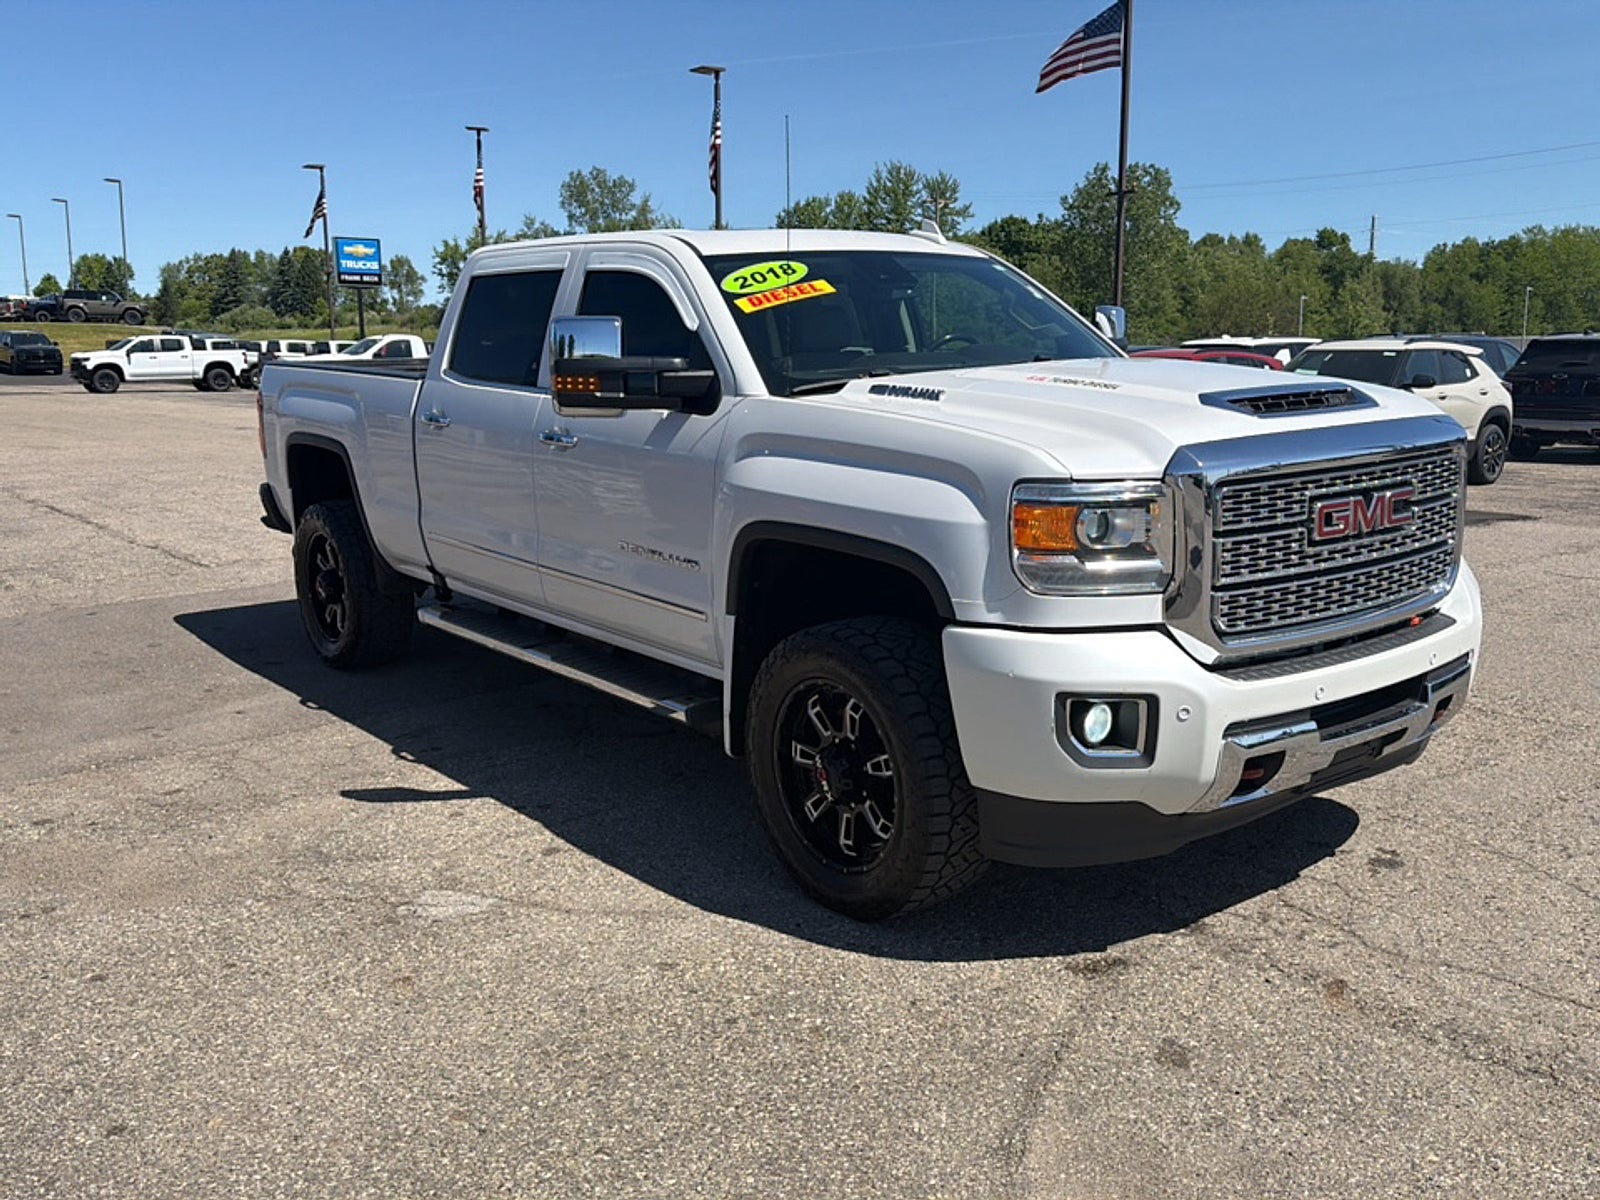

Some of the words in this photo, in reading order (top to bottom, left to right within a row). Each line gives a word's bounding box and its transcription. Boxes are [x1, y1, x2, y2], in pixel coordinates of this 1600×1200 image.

[340, 260, 379, 269] TRUCKS
[733, 263, 798, 290] 2018
[746, 283, 823, 307] DIESEL
[887, 385, 945, 402] DURAMAX
[1314, 486, 1417, 540] GMC
